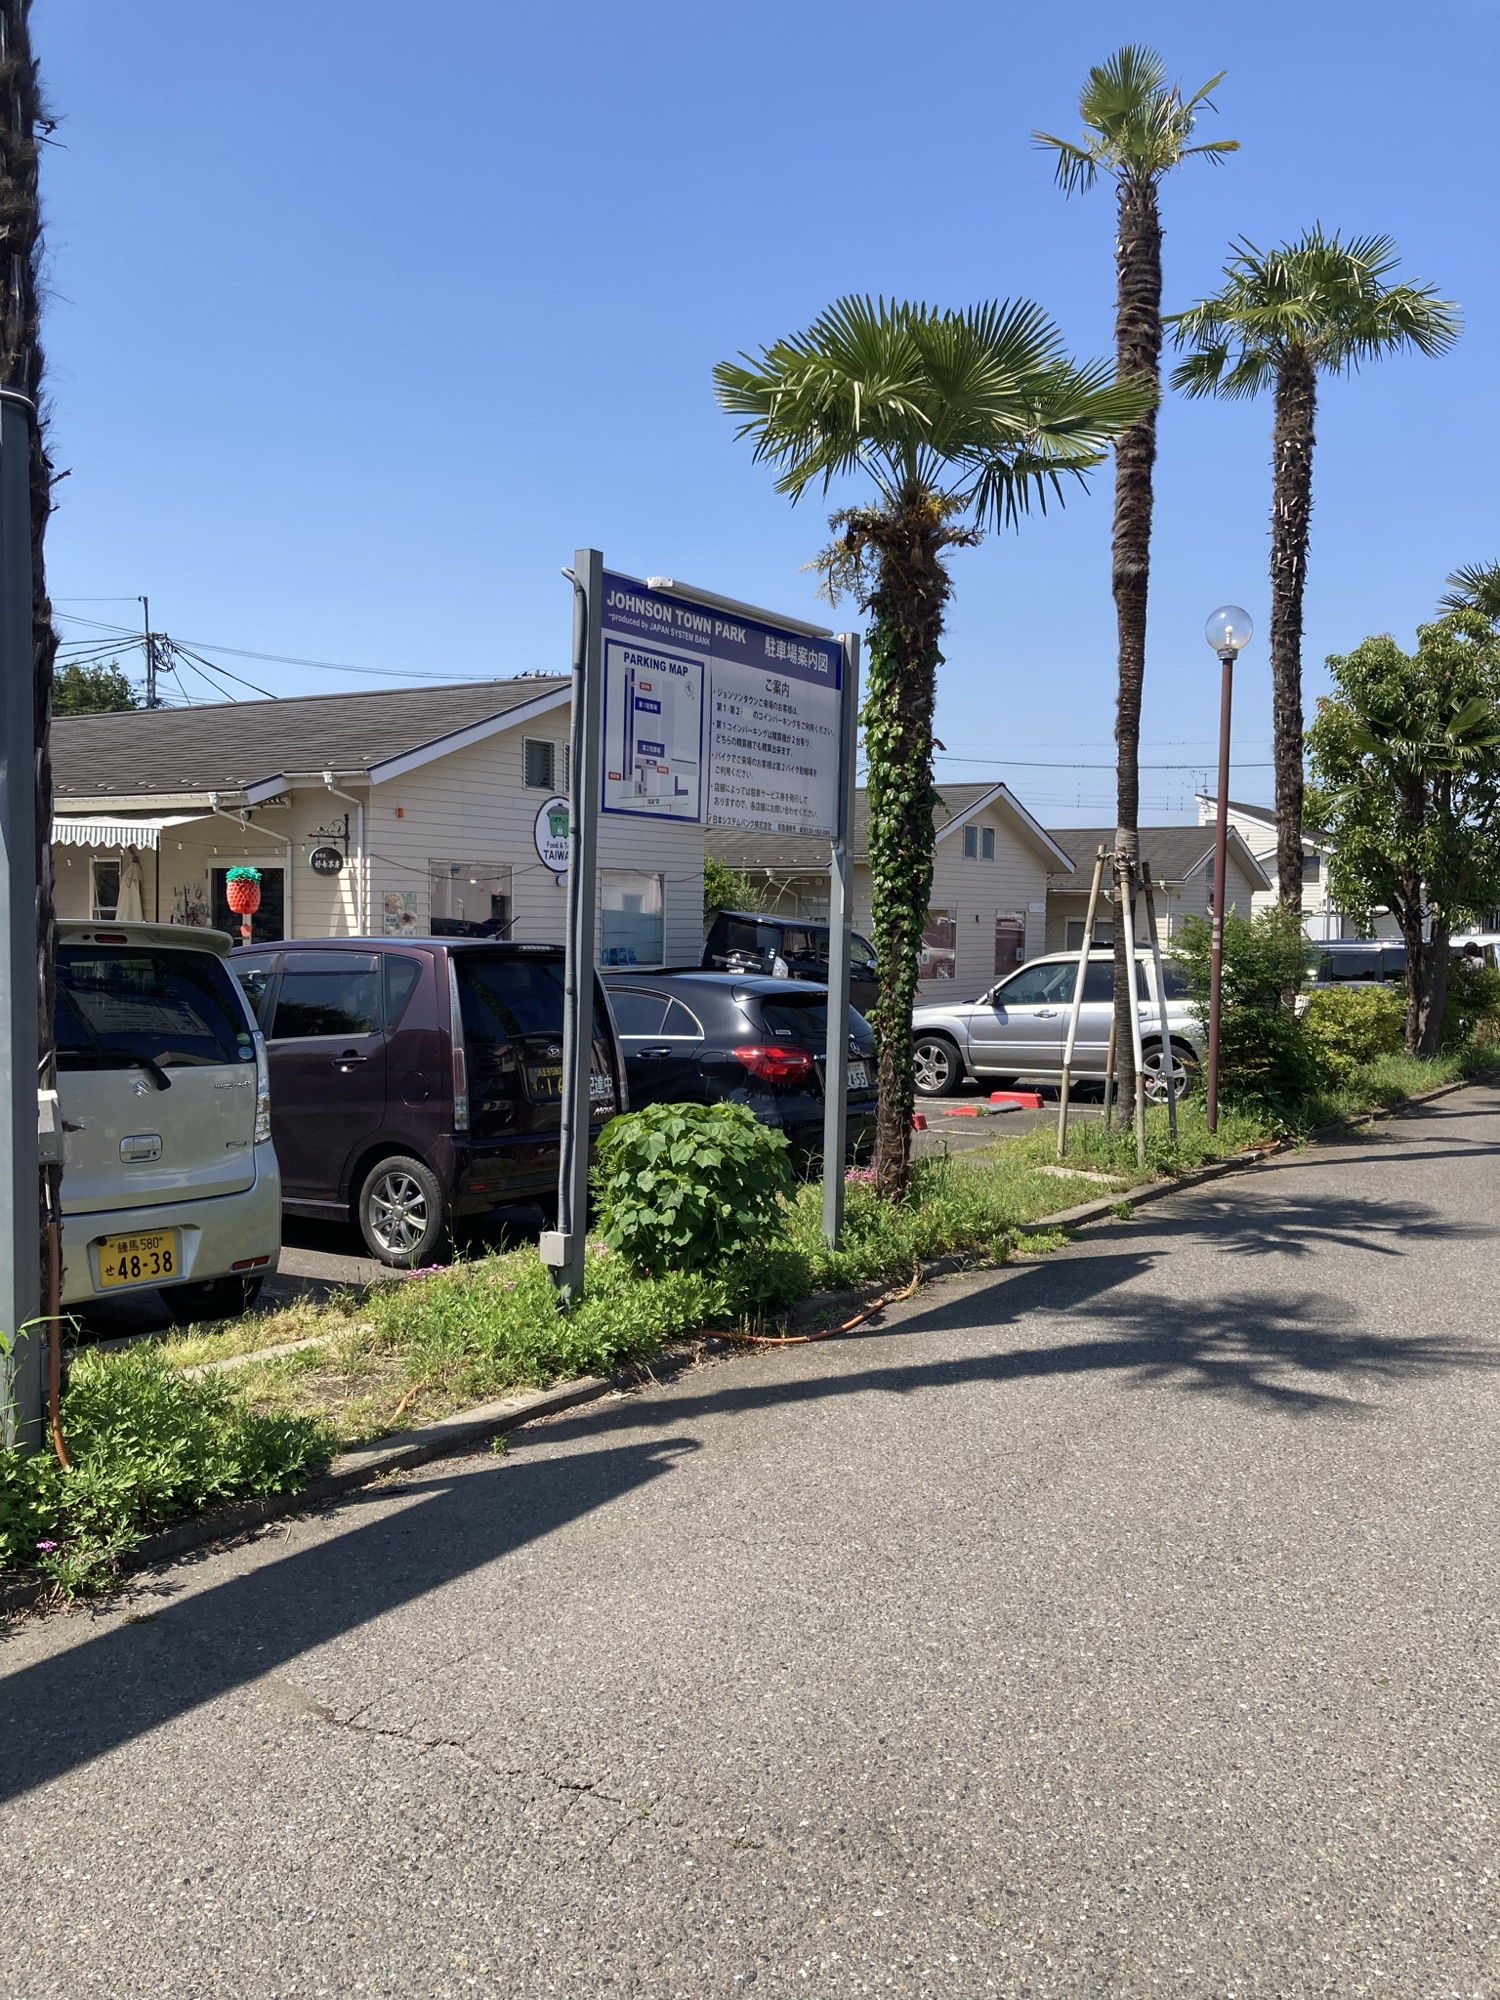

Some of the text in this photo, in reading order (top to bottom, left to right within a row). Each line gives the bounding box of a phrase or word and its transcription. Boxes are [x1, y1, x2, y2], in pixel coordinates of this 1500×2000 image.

[607, 590, 747, 644] JOHNSON TOWN PARK
[641, 621, 649, 630] by
[649, 622, 670, 635] JAPAN
[671, 628, 694, 641] SYSTEM
[695, 635, 711, 647] BANK
[624, 651, 689, 677] PARKING MAP
[765, 636, 829, 673] 駐車場案内図
[765, 678, 790, 698] ご案内
[543, 850, 569, 860] TAIWA
[547, 841, 559, 849] Food
[105, 1250, 173, 1279] せ 48-38
